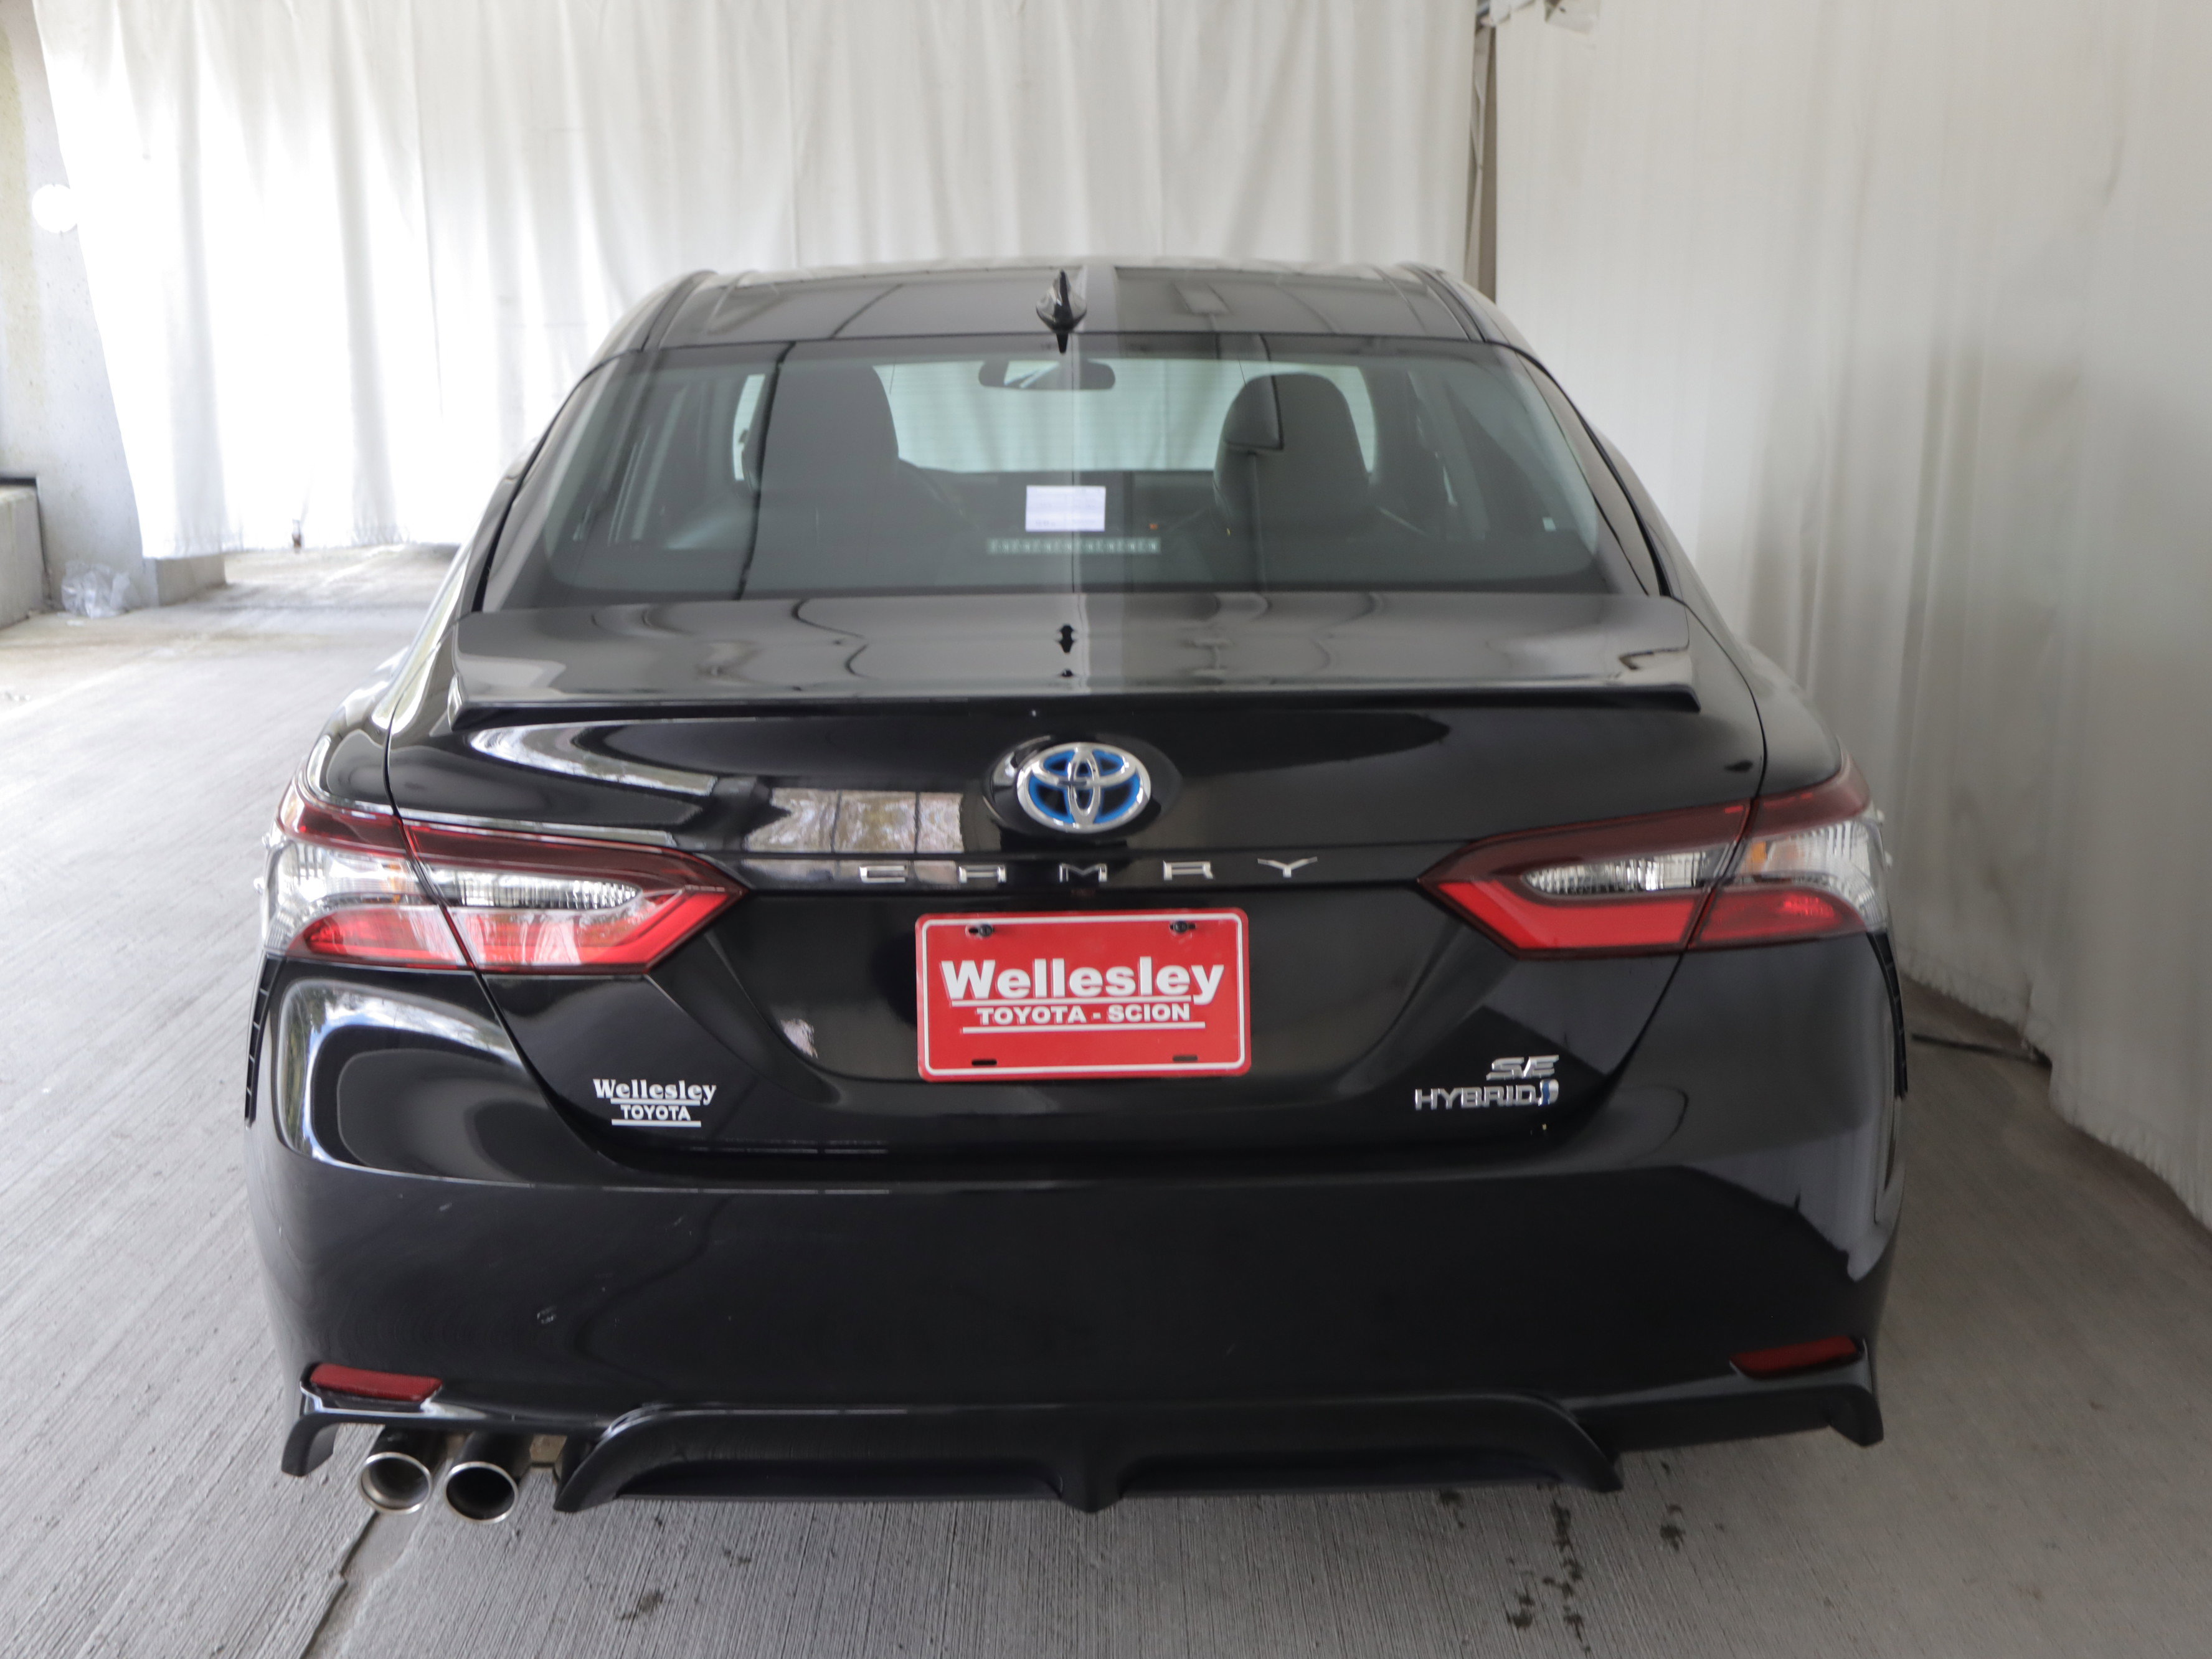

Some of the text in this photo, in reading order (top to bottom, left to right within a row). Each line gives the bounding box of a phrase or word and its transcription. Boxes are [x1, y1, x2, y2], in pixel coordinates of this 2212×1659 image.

[859, 857, 1318, 883] CAMRY
[940, 957, 1224, 1005] Wellesley
[976, 1005, 1087, 1026] TOYOTA
[1108, 1003, 1190, 1023] SCION
[1486, 1054, 1559, 1081] SE
[593, 1079, 716, 1106] Wellesley
[1415, 1084, 1537, 1111] HYBRID
[620, 1104, 691, 1121] TOYOTA
